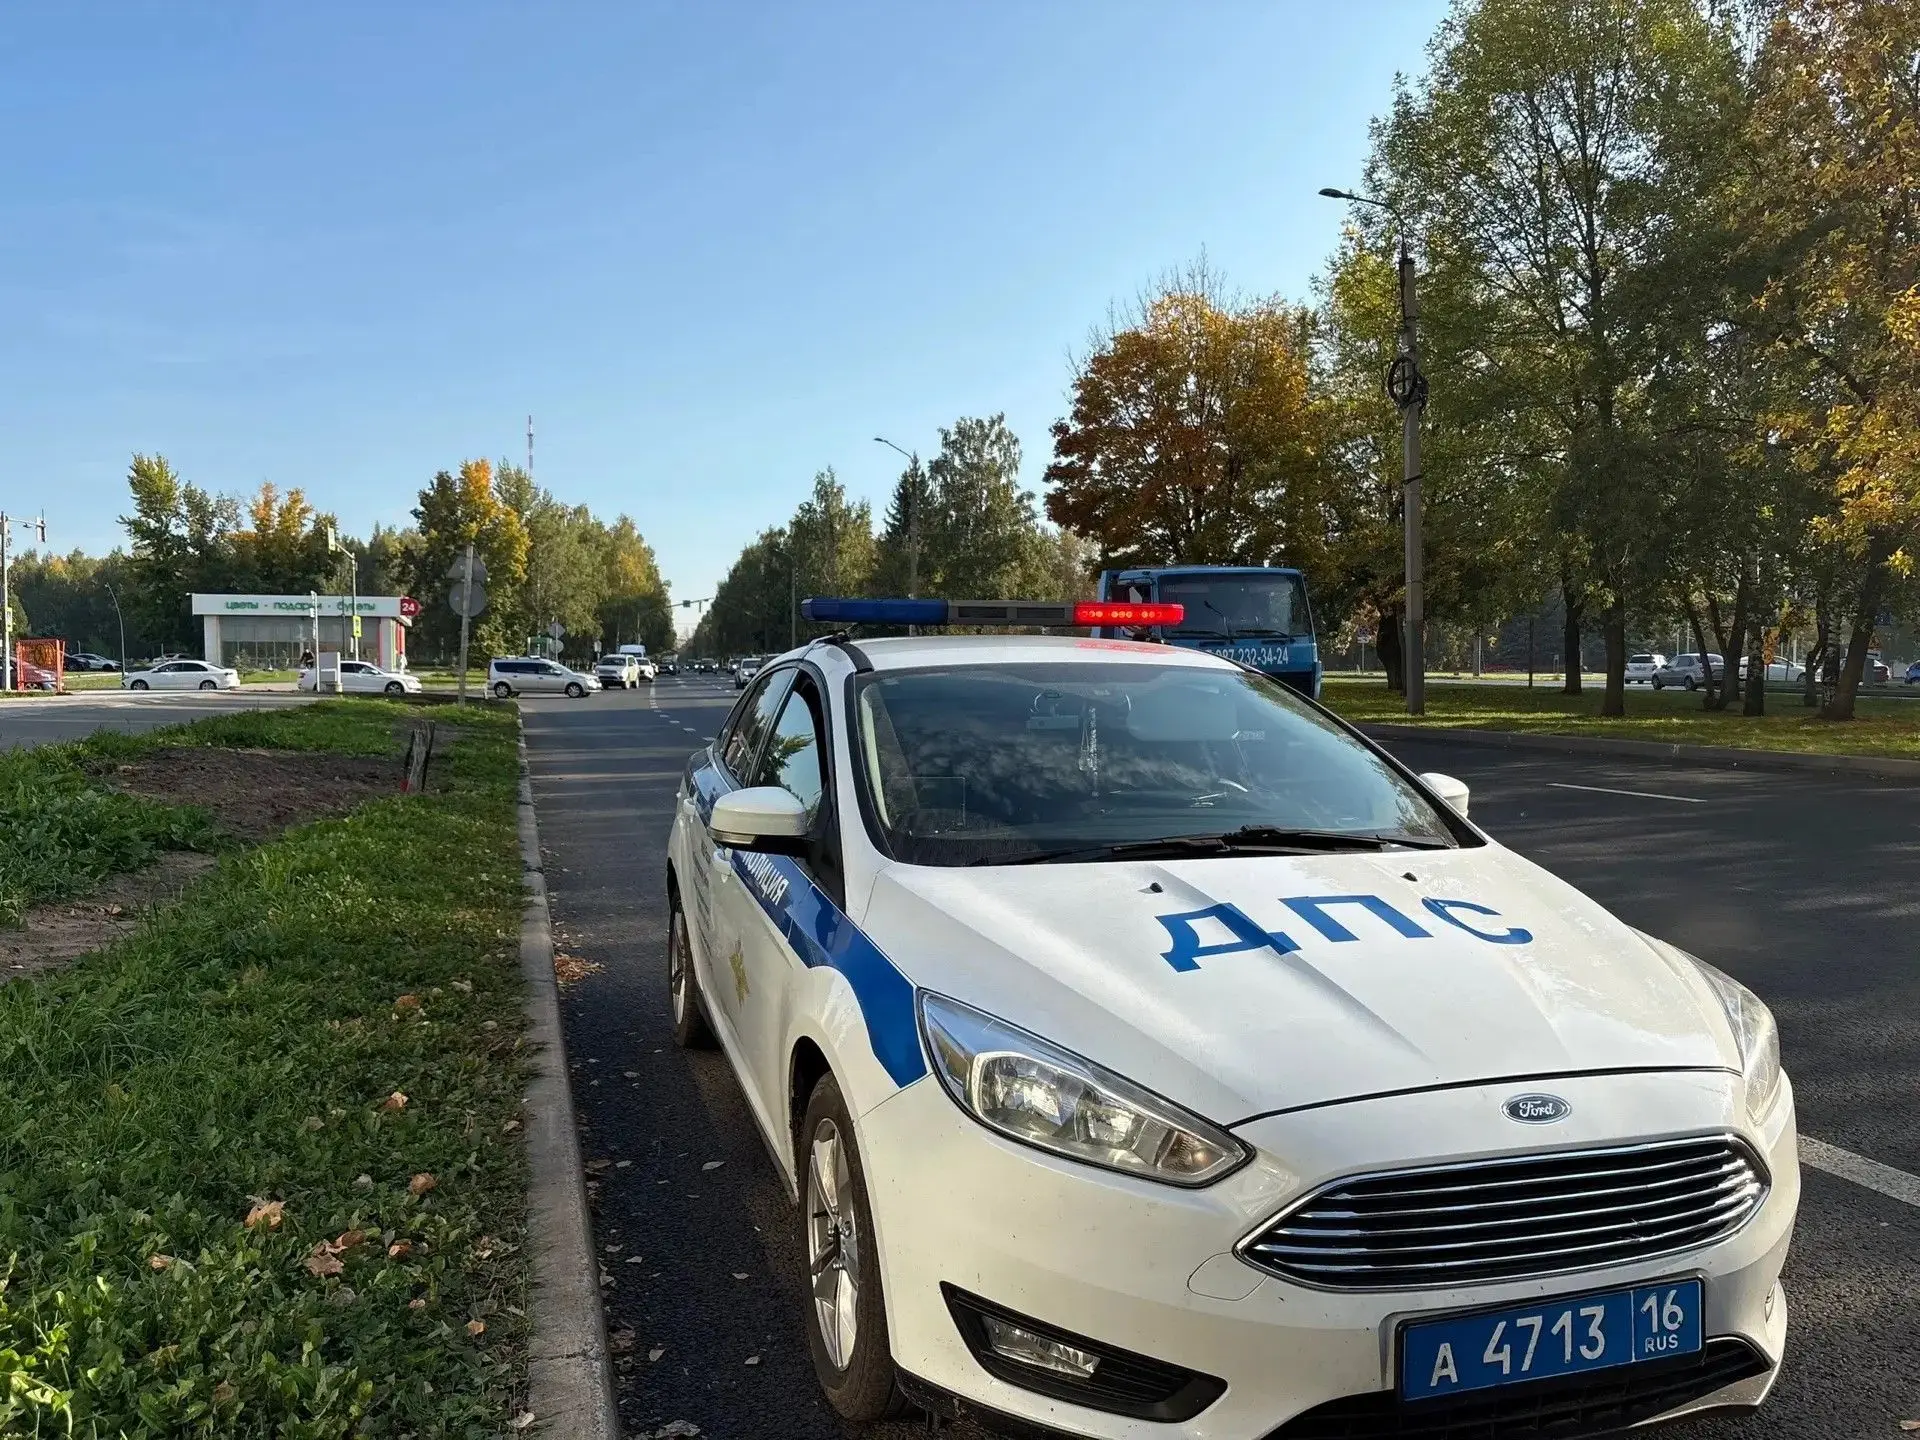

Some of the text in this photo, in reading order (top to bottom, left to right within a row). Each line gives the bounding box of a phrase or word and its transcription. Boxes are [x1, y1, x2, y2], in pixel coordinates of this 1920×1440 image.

[337, 602, 376, 612] буеты
[402, 603, 415, 612] 24
[1238, 647, 1289, 666] 232-34-24
[1154, 894, 1533, 972] ДПС
[1519, 1100, 1556, 1117] Ford
[1483, 1304, 1605, 1374] 4713
[1640, 1289, 1684, 1333] 16
[1645, 1334, 1678, 1353] RUS
